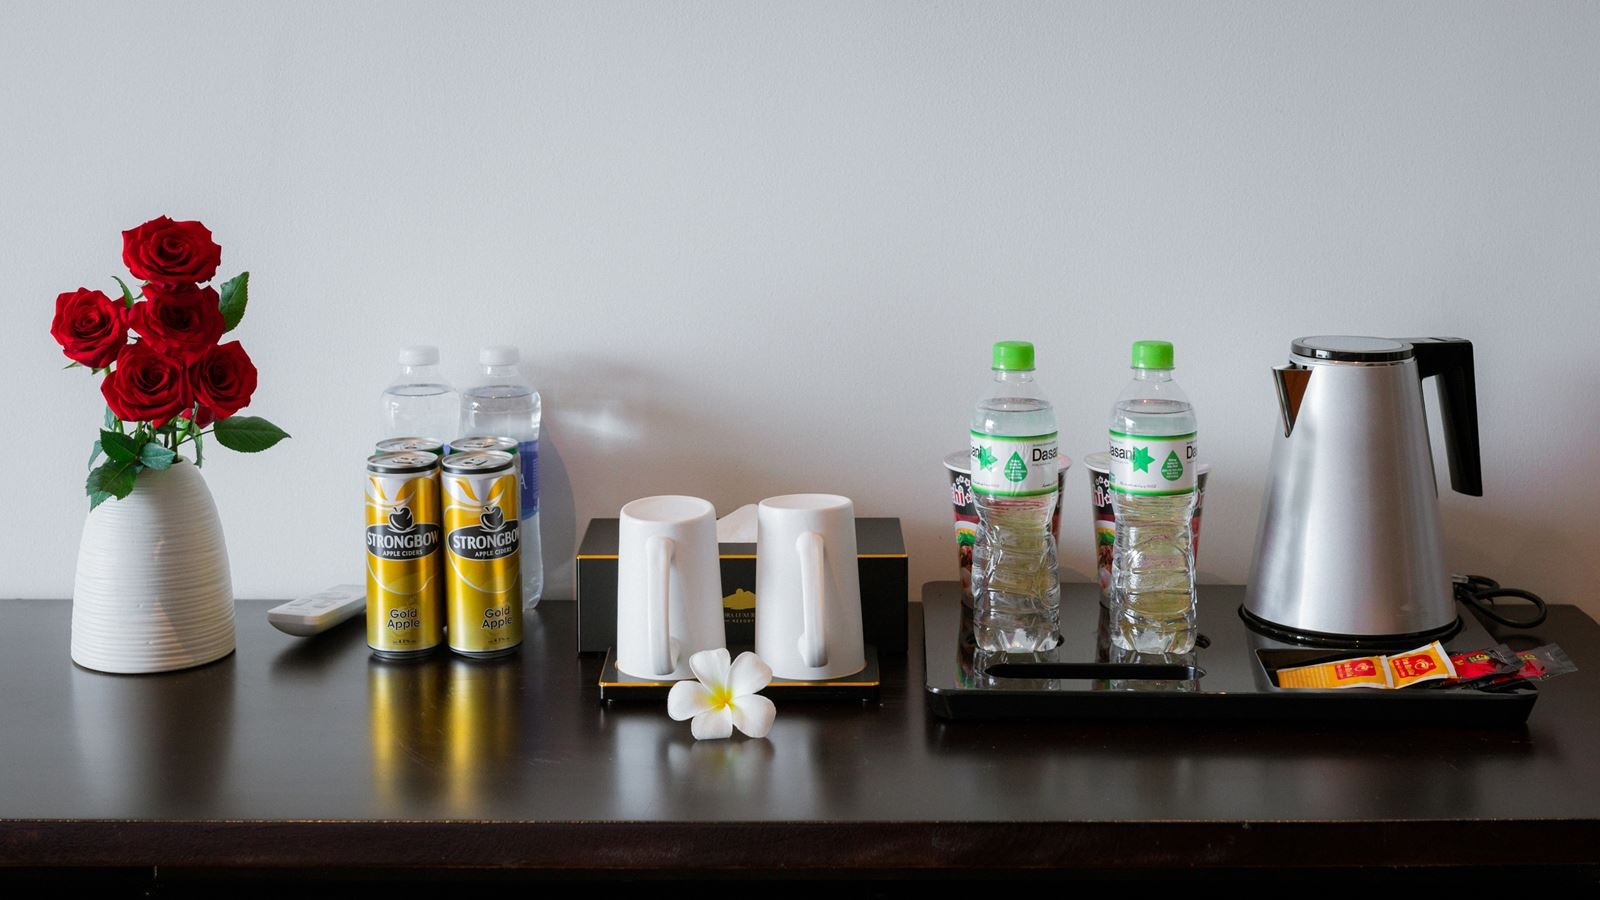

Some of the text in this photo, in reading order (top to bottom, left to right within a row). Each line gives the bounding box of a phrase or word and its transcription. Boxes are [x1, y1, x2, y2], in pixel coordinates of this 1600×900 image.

[1032, 446, 1058, 461] Dasa
[1108, 444, 1136, 460] asani
[367, 530, 438, 548] STRONGBOW
[382, 549, 423, 557] APPLE CIDERS
[475, 546, 512, 558] APPLE CIDERS
[390, 608, 417, 619] Gold
[484, 606, 510, 619] Gold
[387, 619, 420, 631] Apple
[482, 615, 513, 630] Apple
